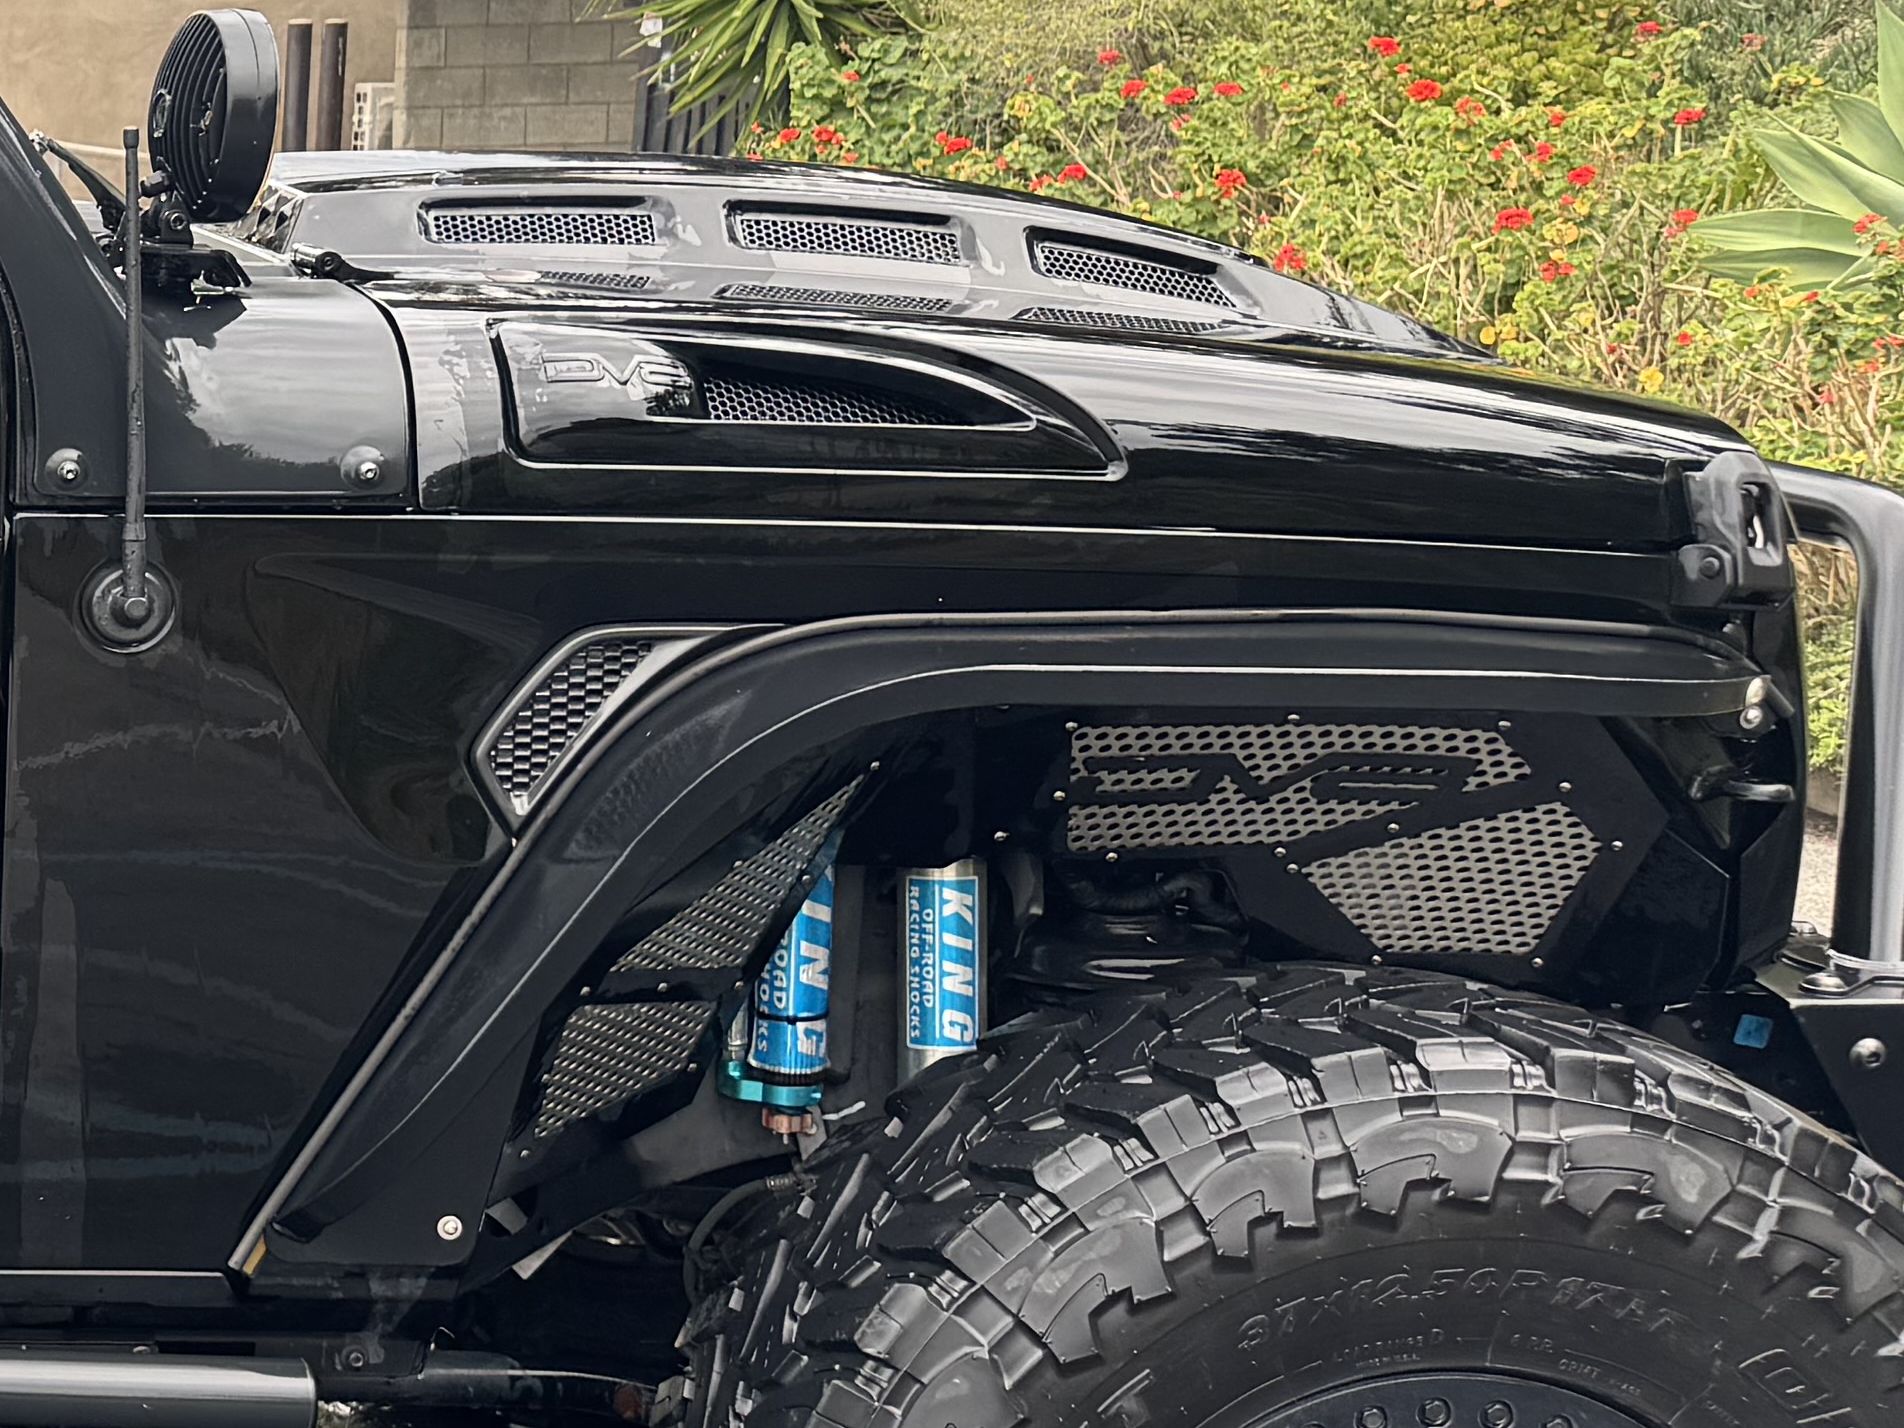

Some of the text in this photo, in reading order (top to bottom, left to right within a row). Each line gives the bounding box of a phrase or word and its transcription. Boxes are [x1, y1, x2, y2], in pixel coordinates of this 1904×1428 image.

[797, 898, 833, 1059] ING
[909, 885, 921, 1038] RACING SHOCKS
[921, 908, 934, 1008] OFF-ROAD
[941, 887, 974, 1043] KING
